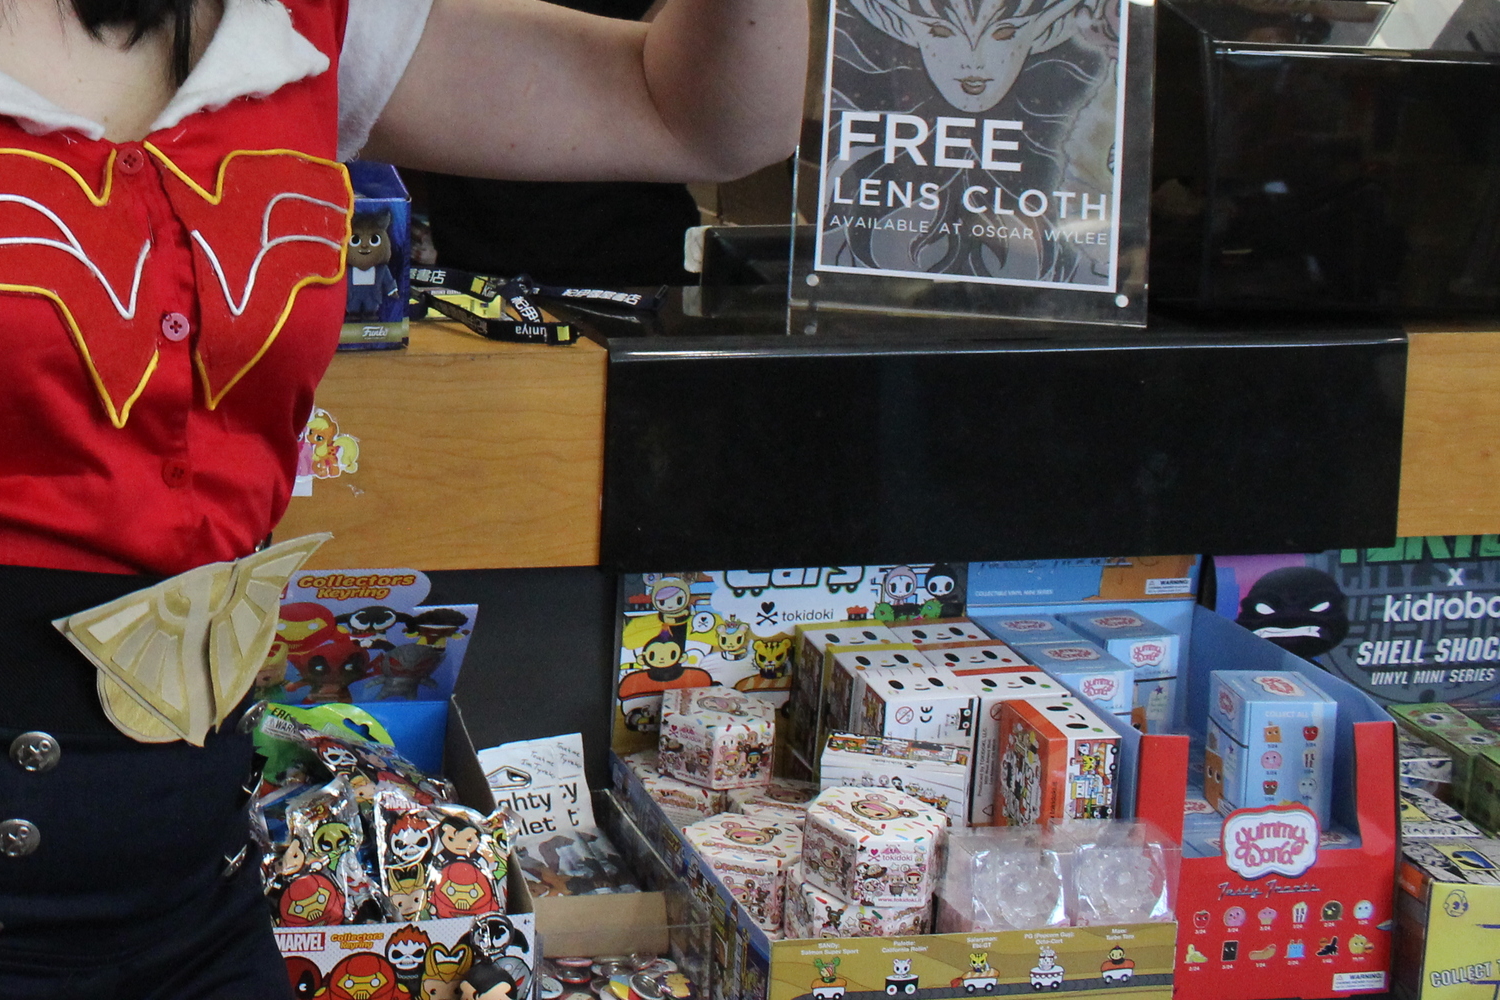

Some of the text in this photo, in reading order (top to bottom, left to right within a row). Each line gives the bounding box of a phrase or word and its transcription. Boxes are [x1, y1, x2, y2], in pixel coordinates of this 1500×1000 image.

[839, 111, 1023, 172] FREE
[834, 177, 1106, 221] LENS CLOTH
[830, 215, 1107, 246] AVAILABLE AT OSCAR WYLEE
[362, 326, 389, 337] Funko
[297, 574, 416, 588] Collectors
[316, 587, 390, 601] Keyring
[782, 609, 834, 622] tokidoki
[1356, 636, 1500, 666] SHELL SHOC
[1371, 668, 1495, 685] VINYL MINI SERIES
[519, 817, 556, 836] let
[882, 853, 913, 862] tokidoki
[276, 933, 325, 951] MARVEL
[330, 932, 384, 942] Collectors
[340, 940, 373, 950] Keyring
[1430, 962, 1492, 988] COLLECT
